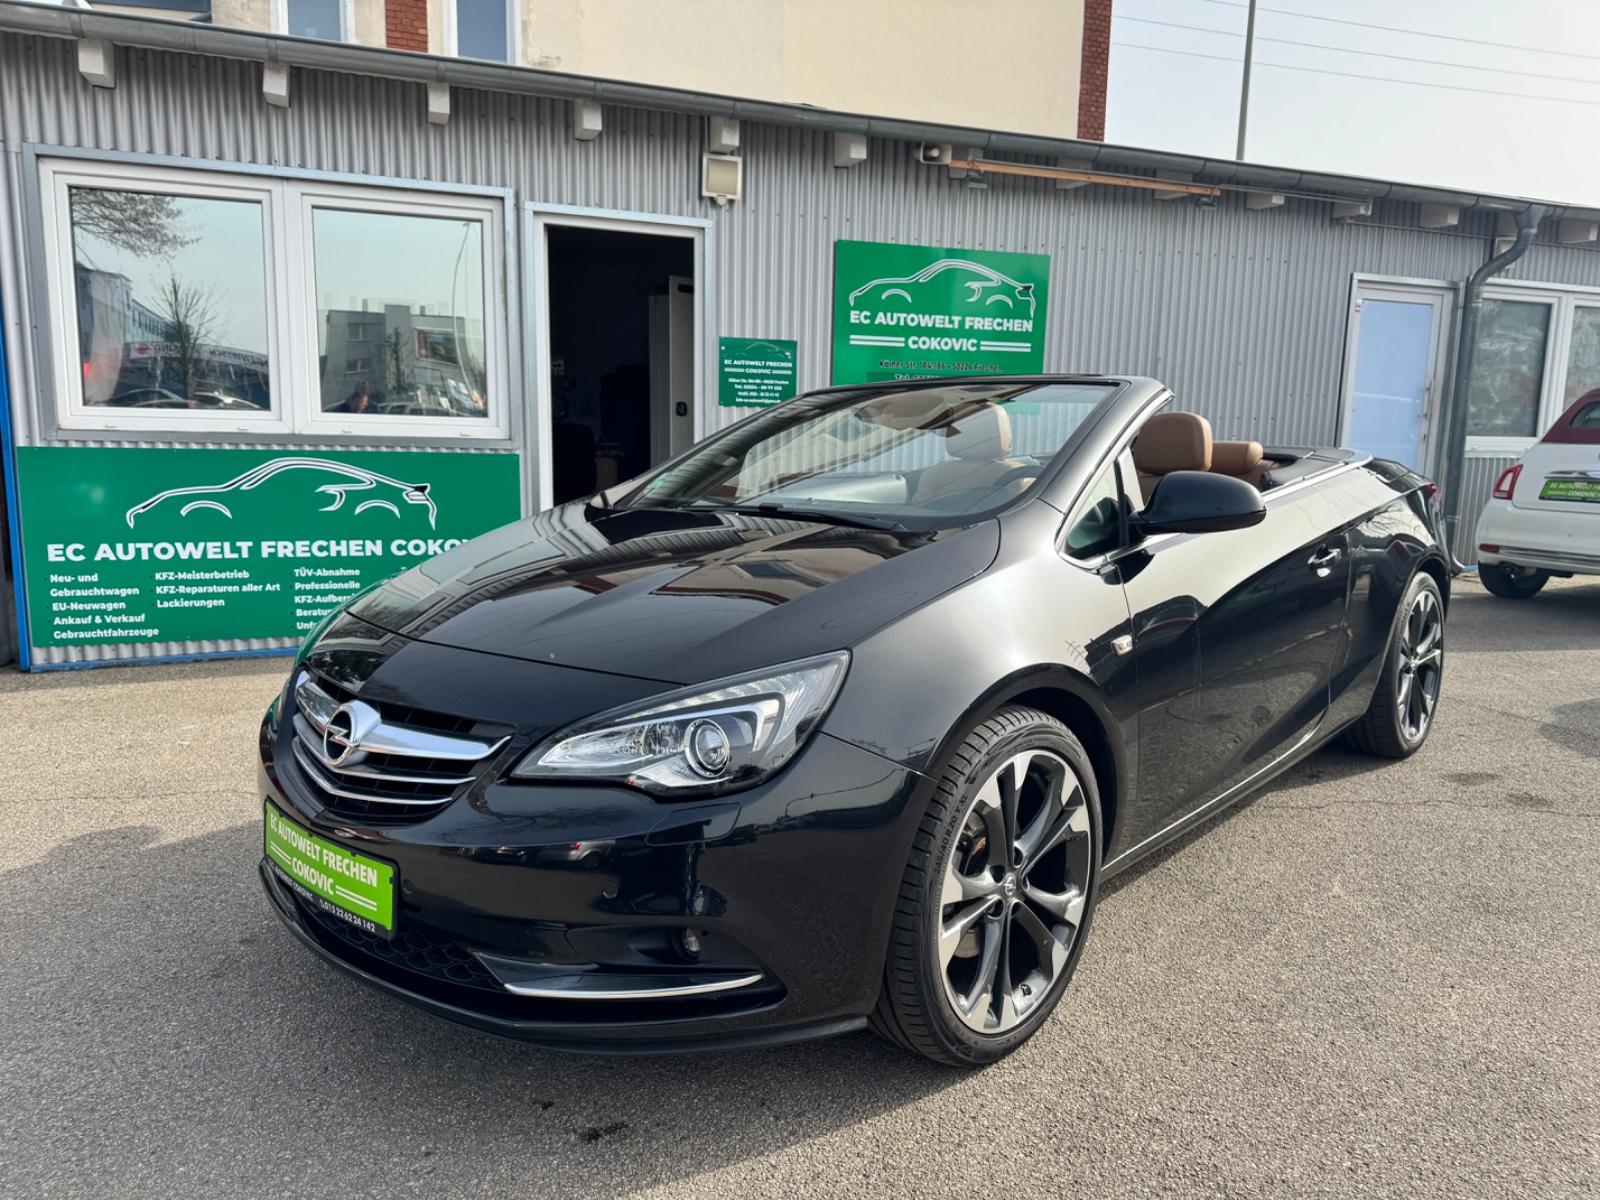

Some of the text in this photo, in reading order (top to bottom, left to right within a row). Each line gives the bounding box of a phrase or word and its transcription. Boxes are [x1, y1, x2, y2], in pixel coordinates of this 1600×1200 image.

[850, 310, 1033, 332] EC AUTOWELT FRECHEN
[908, 336, 977, 351] COKOVIC
[47, 543, 86, 561] EC
[94, 541, 253, 560] AUTOWELT
[261, 539, 383, 558] FRECHEN
[155, 569, 250, 580] KFZ-Meisterbetrieb
[294, 567, 360, 577] TÜV-Abnahme
[50, 573, 98, 583] Neu- und
[156, 583, 281, 595] KFZ-Reparaturen aller Art
[294, 581, 360, 590] Professionelle
[50, 587, 139, 597] Gebrauchtwagen
[52, 602, 126, 611] EU-Neuwagen
[157, 598, 225, 608] Lackierungen
[54, 615, 92, 625] Ankauf
[104, 613, 145, 623] Verkauf
[54, 628, 159, 639] Gebrauchtfahrzeuge
[270, 813, 277, 833] EC
[278, 822, 320, 862] AUTOWELT
[322, 848, 378, 888] FRECHEN
[292, 857, 334, 896] COKOVIC
